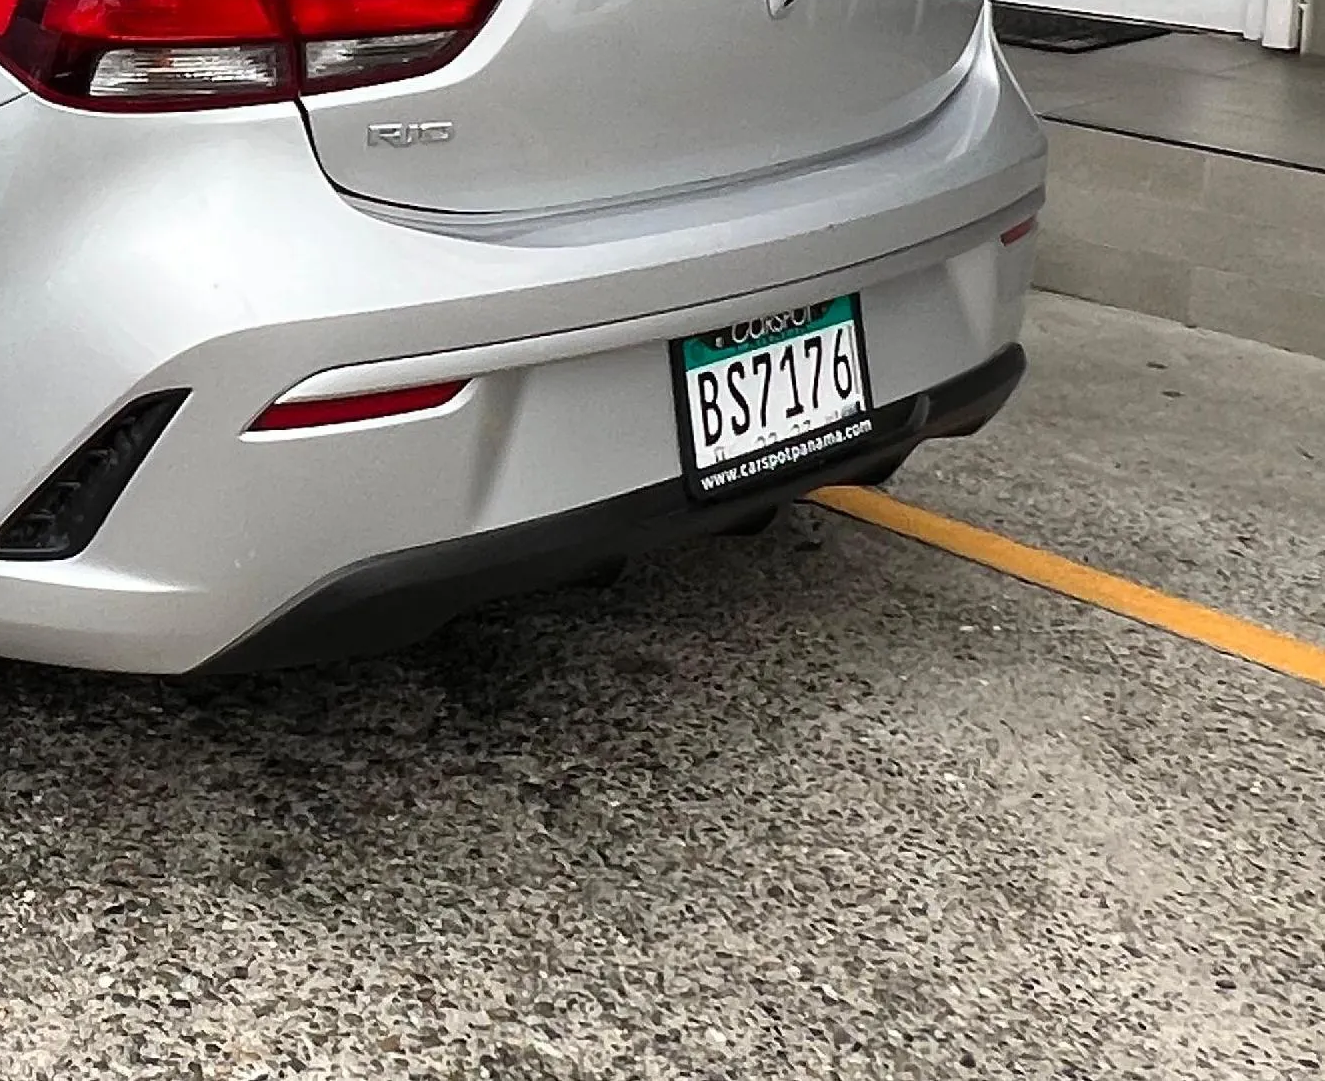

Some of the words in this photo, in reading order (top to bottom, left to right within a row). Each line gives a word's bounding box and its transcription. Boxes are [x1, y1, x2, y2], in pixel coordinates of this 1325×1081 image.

[366, 121, 455, 148] RIO
[698, 328, 852, 447] BS7176
[700, 419, 872, 491] www.carspotpanama.com
